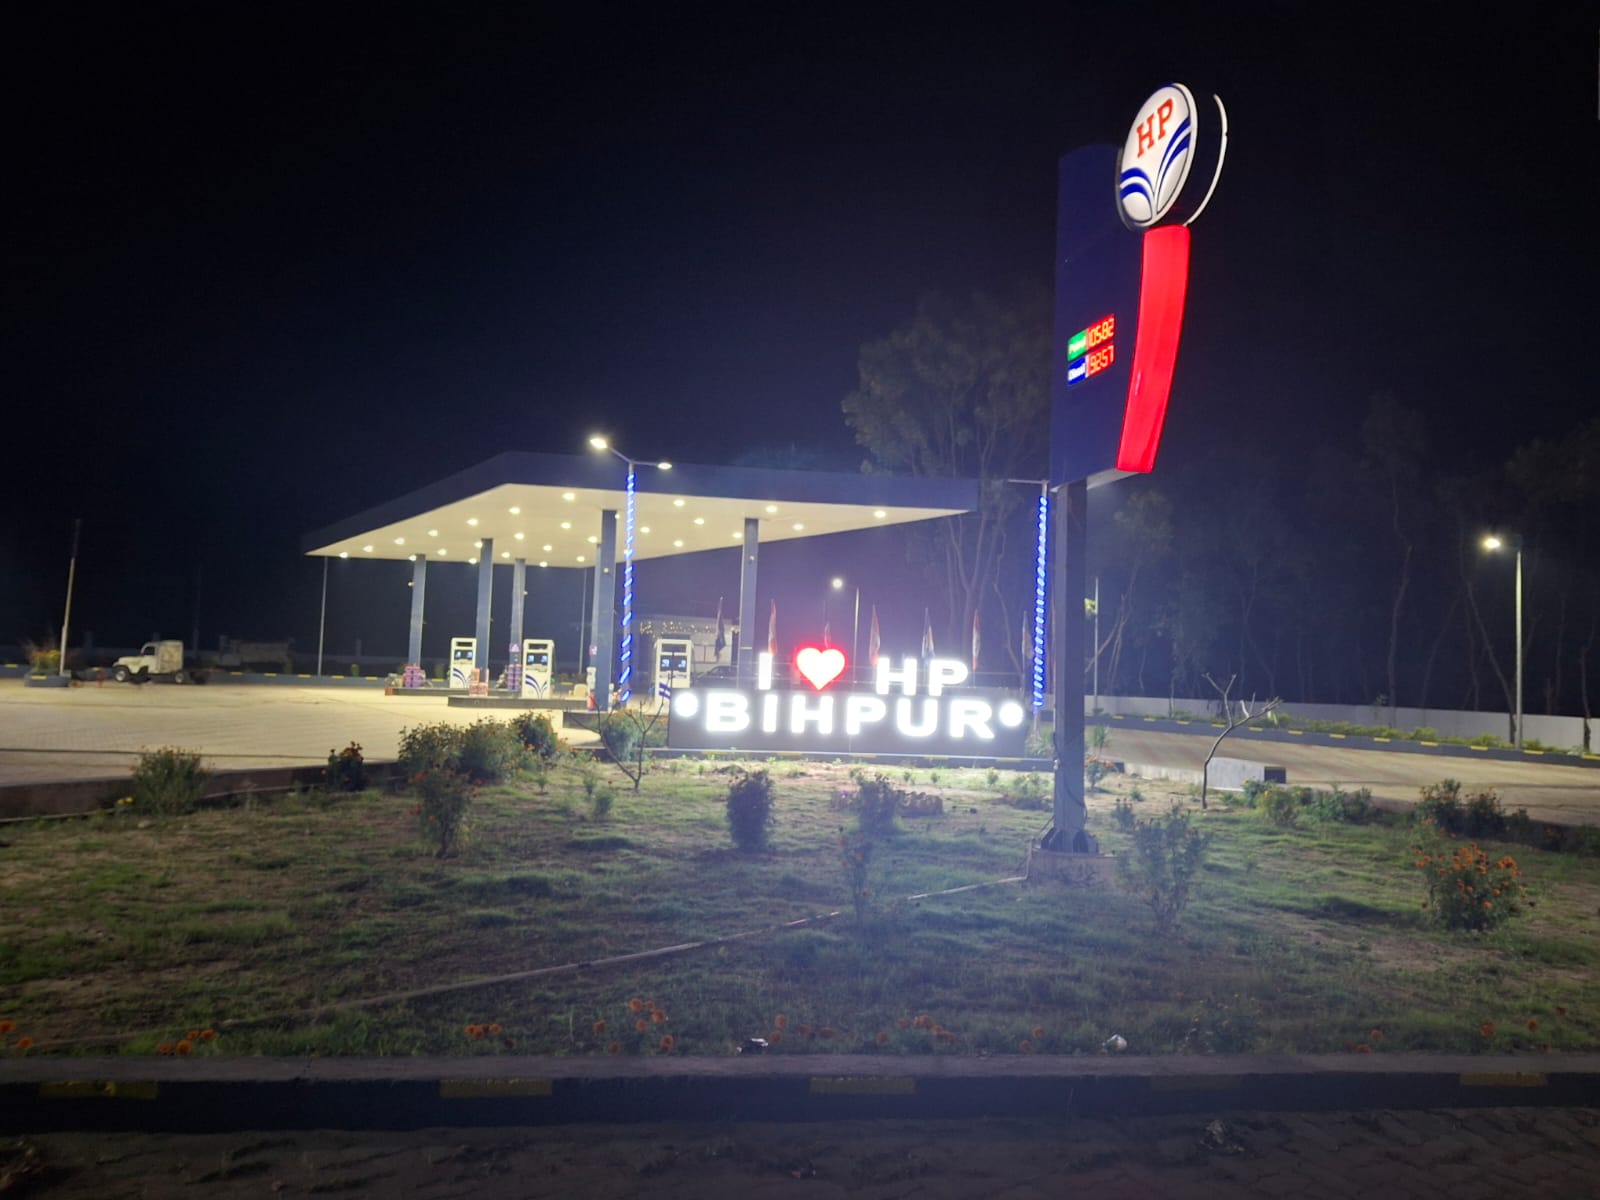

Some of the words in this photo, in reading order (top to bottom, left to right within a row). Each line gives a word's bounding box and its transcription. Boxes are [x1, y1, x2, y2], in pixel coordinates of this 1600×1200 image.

[1136, 98, 1173, 158] HP
[758, 652, 773, 690] I
[875, 657, 969, 697] HP
[704, 692, 995, 739] BIHPUR
